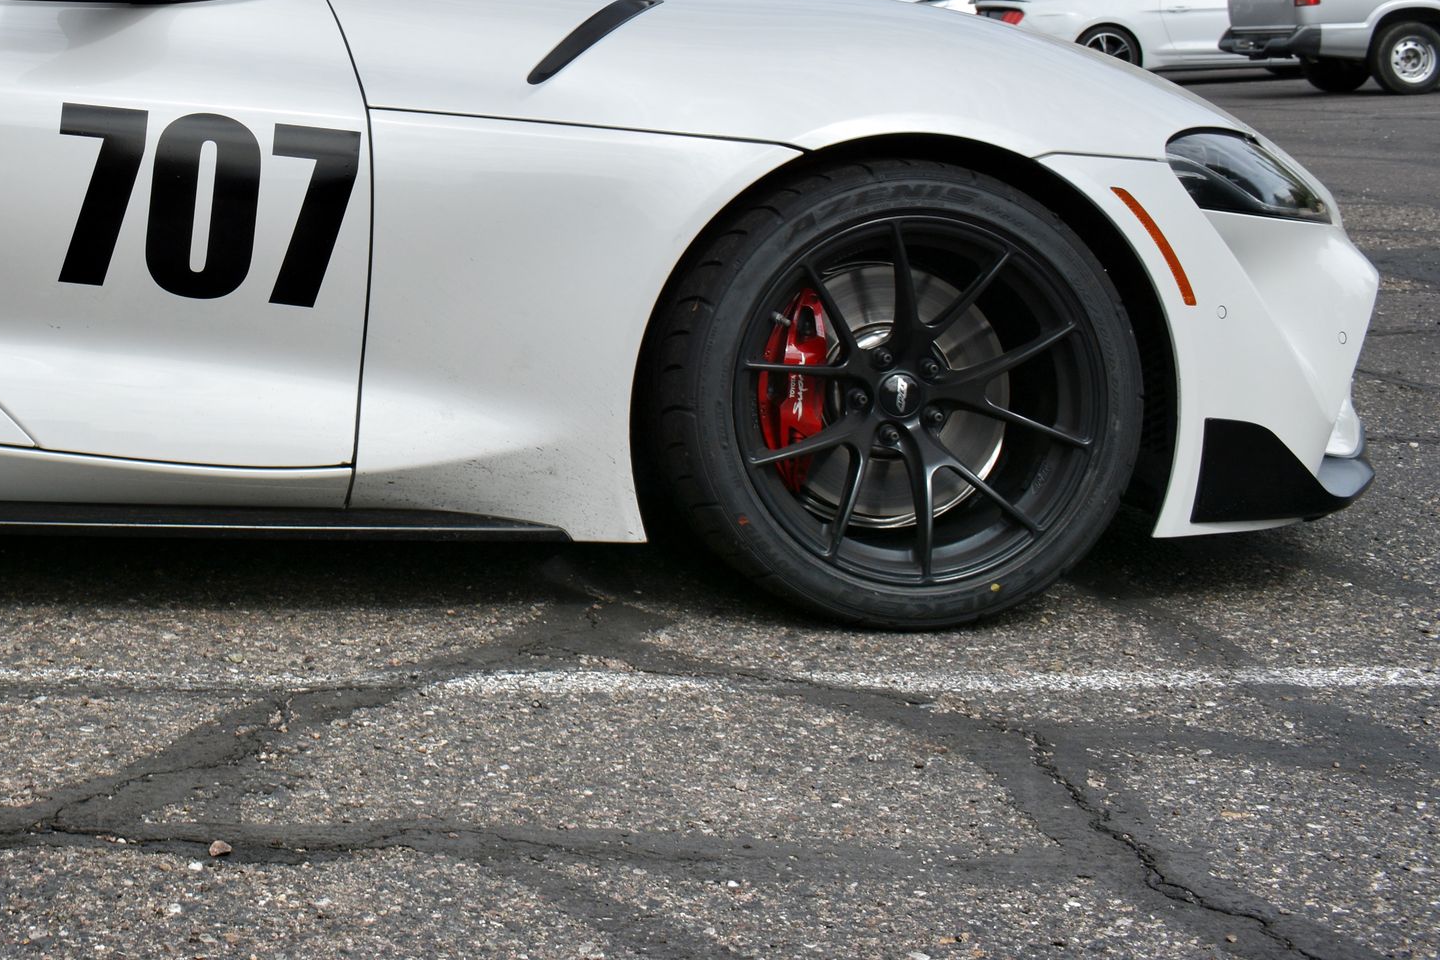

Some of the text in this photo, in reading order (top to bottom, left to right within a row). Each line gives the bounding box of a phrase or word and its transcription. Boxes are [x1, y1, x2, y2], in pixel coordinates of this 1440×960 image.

[58, 102, 361, 308] 707
[783, 184, 979, 247] AZENIS
[789, 374, 797, 399] TOYOTA
